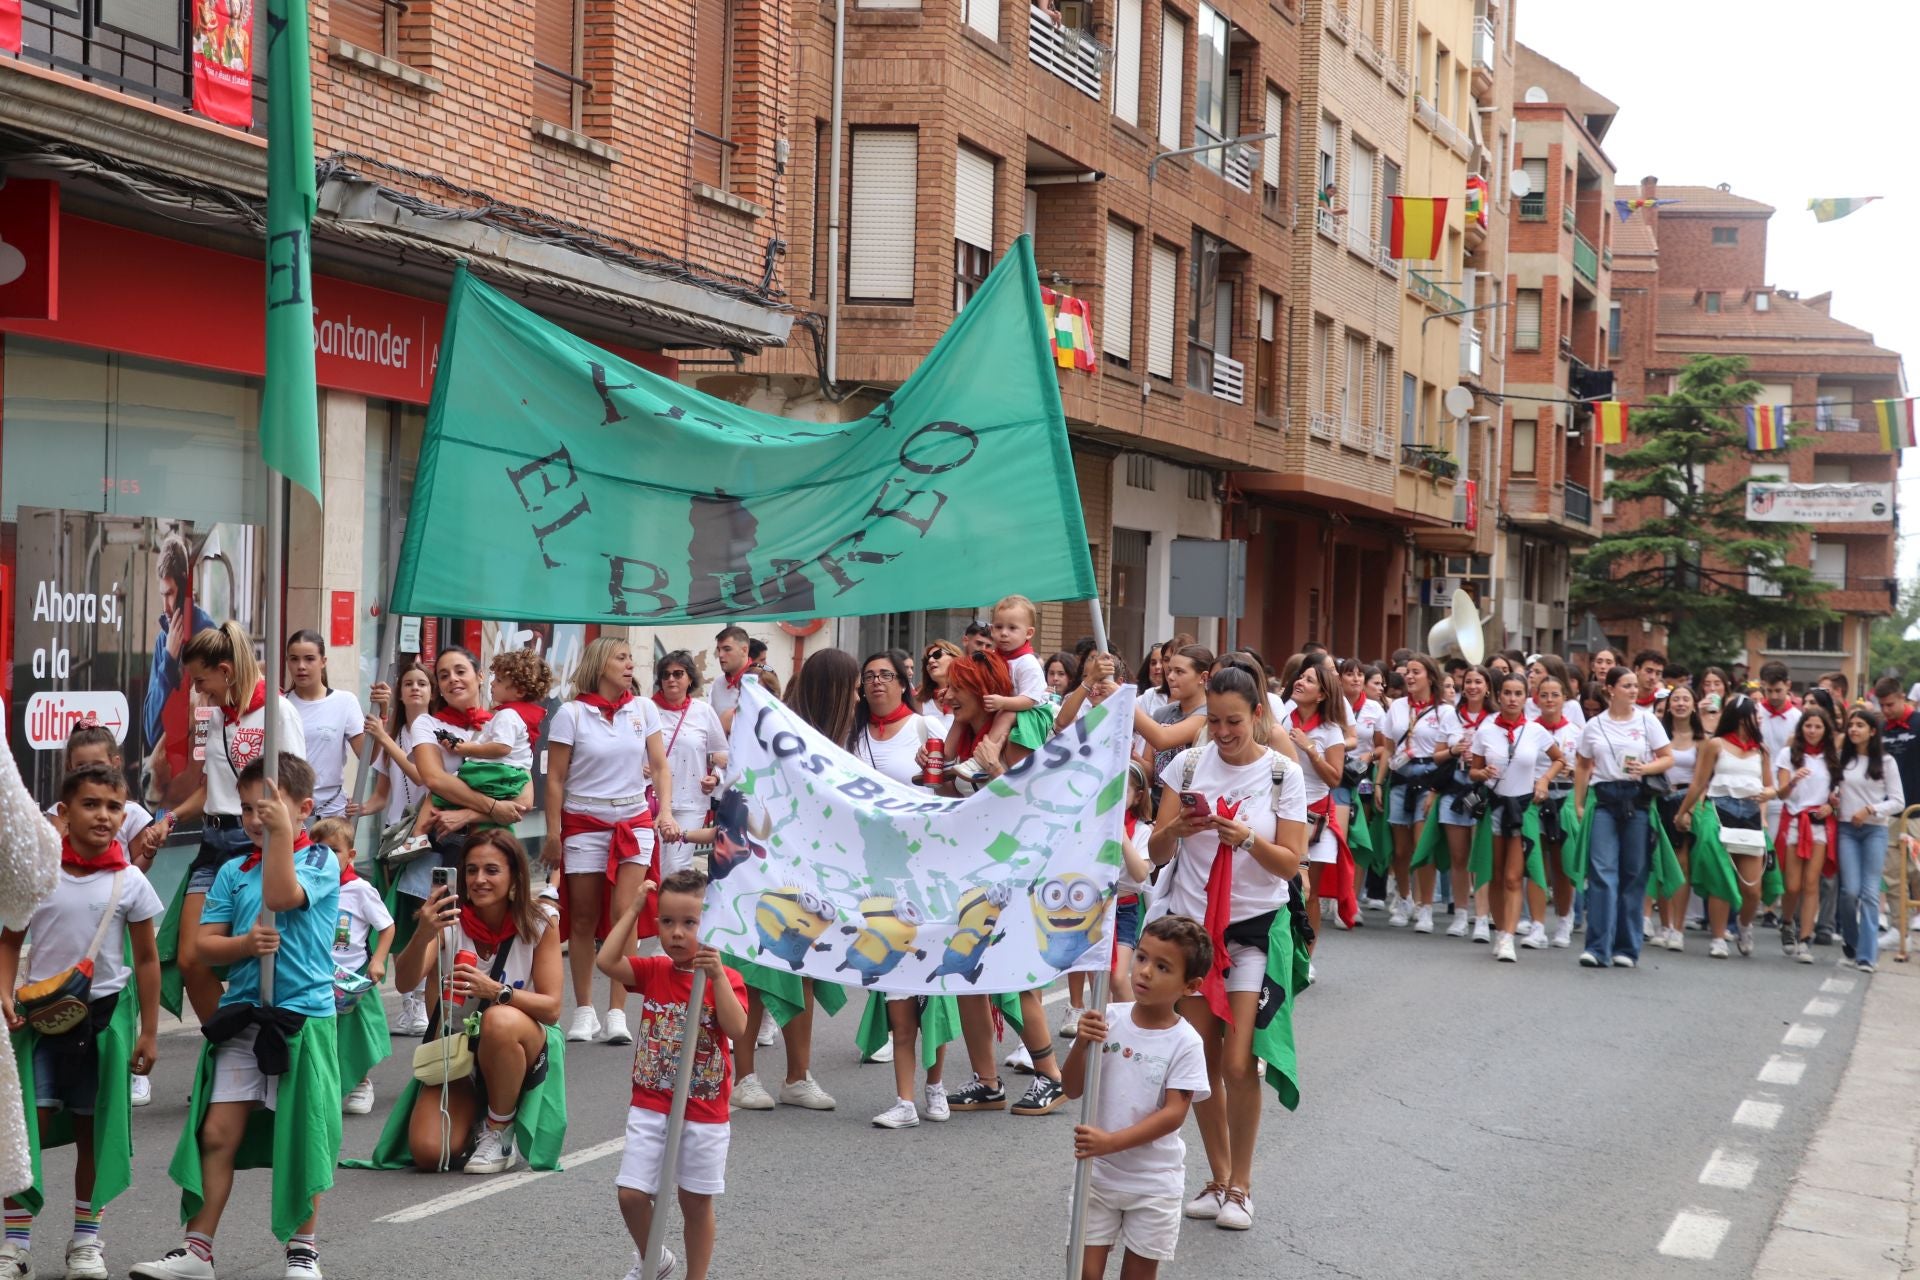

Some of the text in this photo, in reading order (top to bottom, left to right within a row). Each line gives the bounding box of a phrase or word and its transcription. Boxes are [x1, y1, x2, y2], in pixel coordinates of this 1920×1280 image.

[33, 580, 122, 632] Ahora sí,
[33, 637, 70, 679] a la
